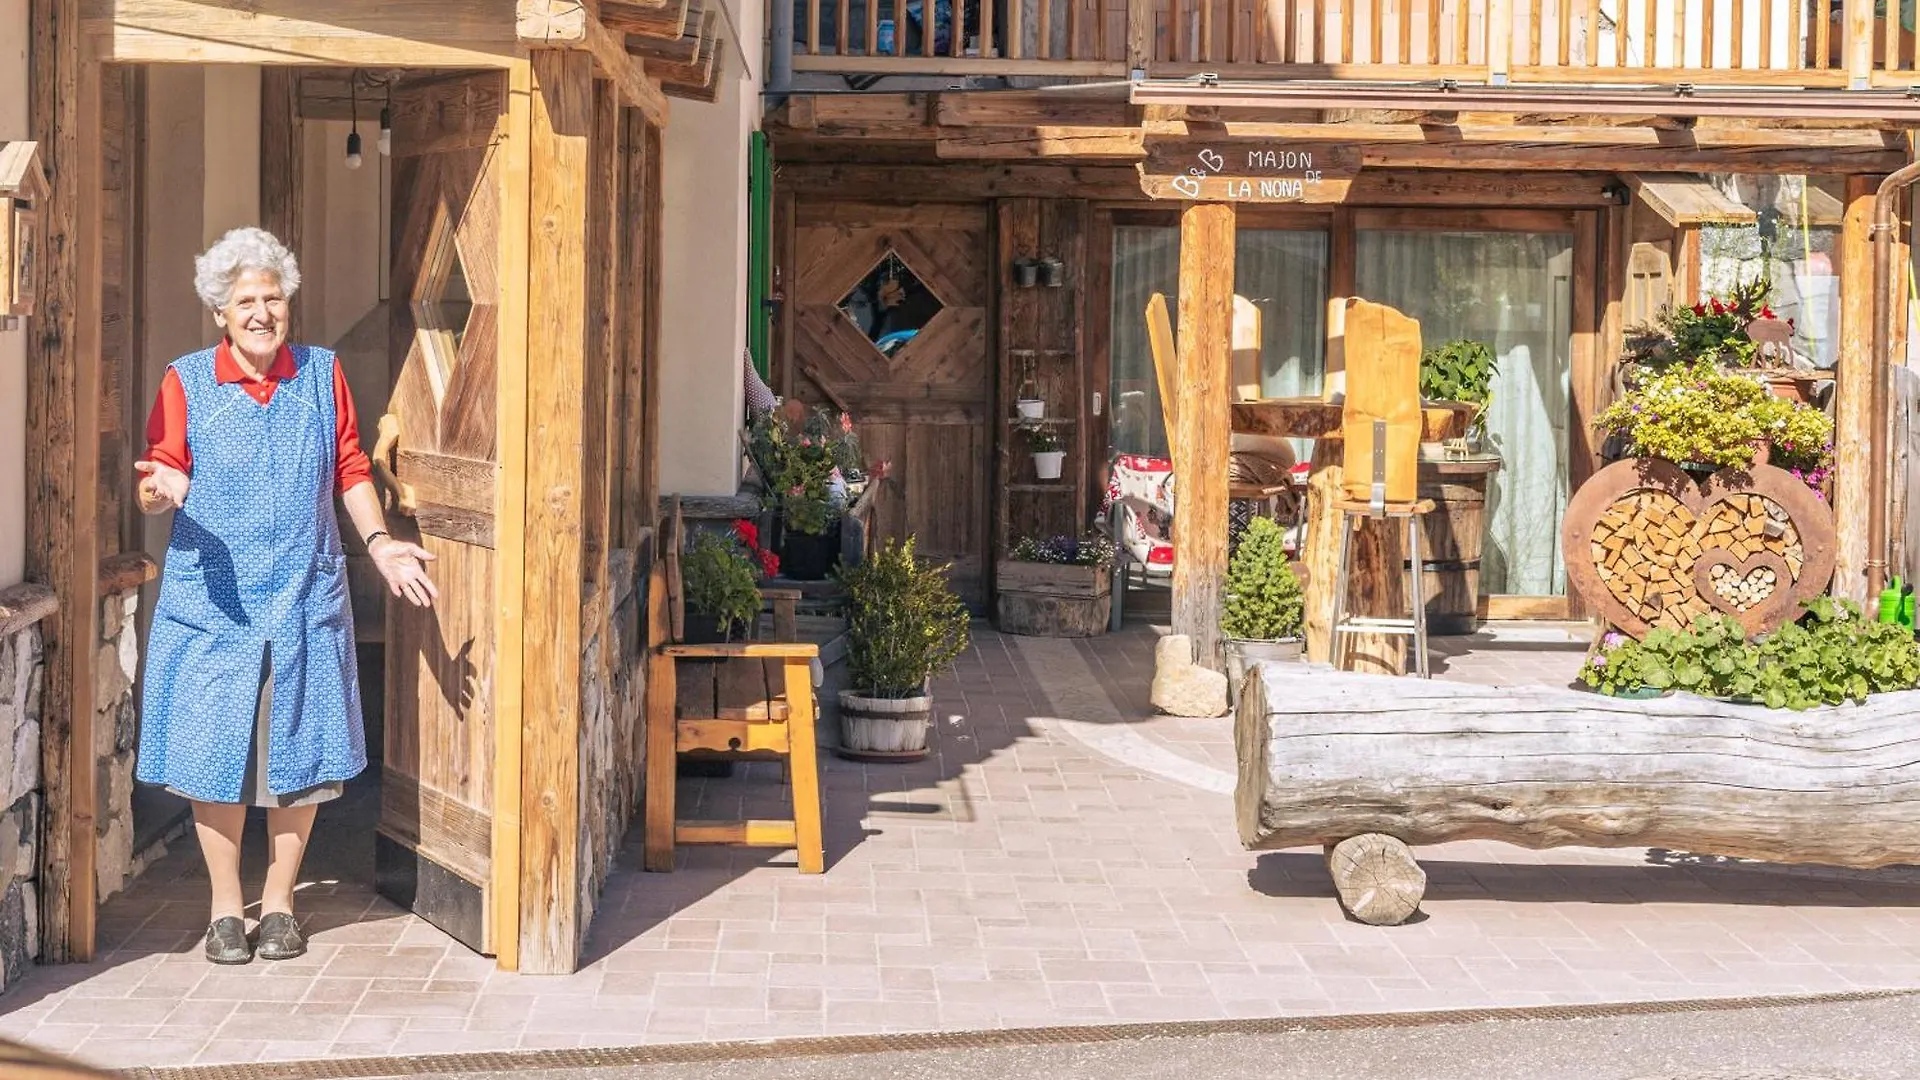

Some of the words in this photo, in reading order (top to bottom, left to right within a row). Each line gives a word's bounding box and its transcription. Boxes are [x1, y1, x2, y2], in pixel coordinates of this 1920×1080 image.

[1248, 151, 1312, 169] MAJON
[1172, 149, 1224, 198] B&B
[1305, 170, 1322, 184] DE
[1228, 181, 1251, 198] LA
[1261, 181, 1304, 198] NONA
